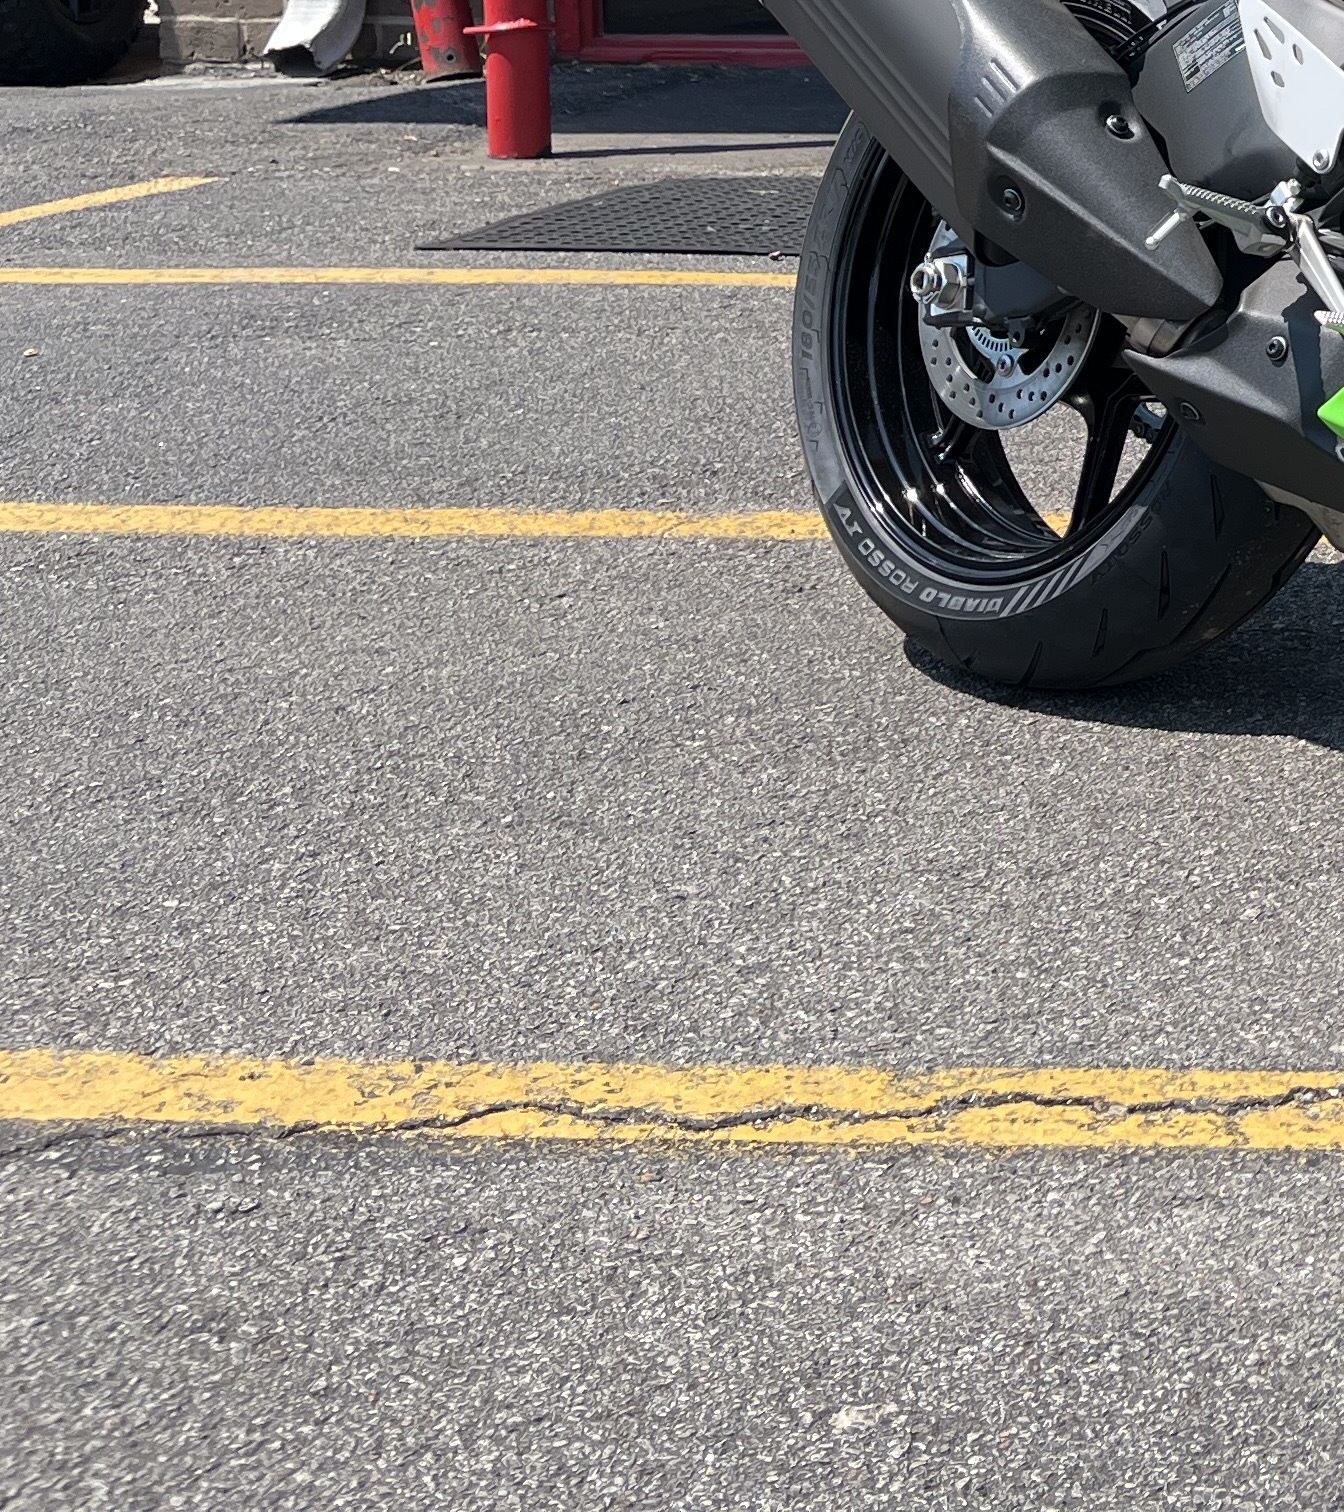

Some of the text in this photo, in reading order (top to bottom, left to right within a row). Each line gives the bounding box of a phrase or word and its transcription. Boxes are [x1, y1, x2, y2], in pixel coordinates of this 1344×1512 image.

[833, 503, 1005, 614] DIABLO ROSSO IV
